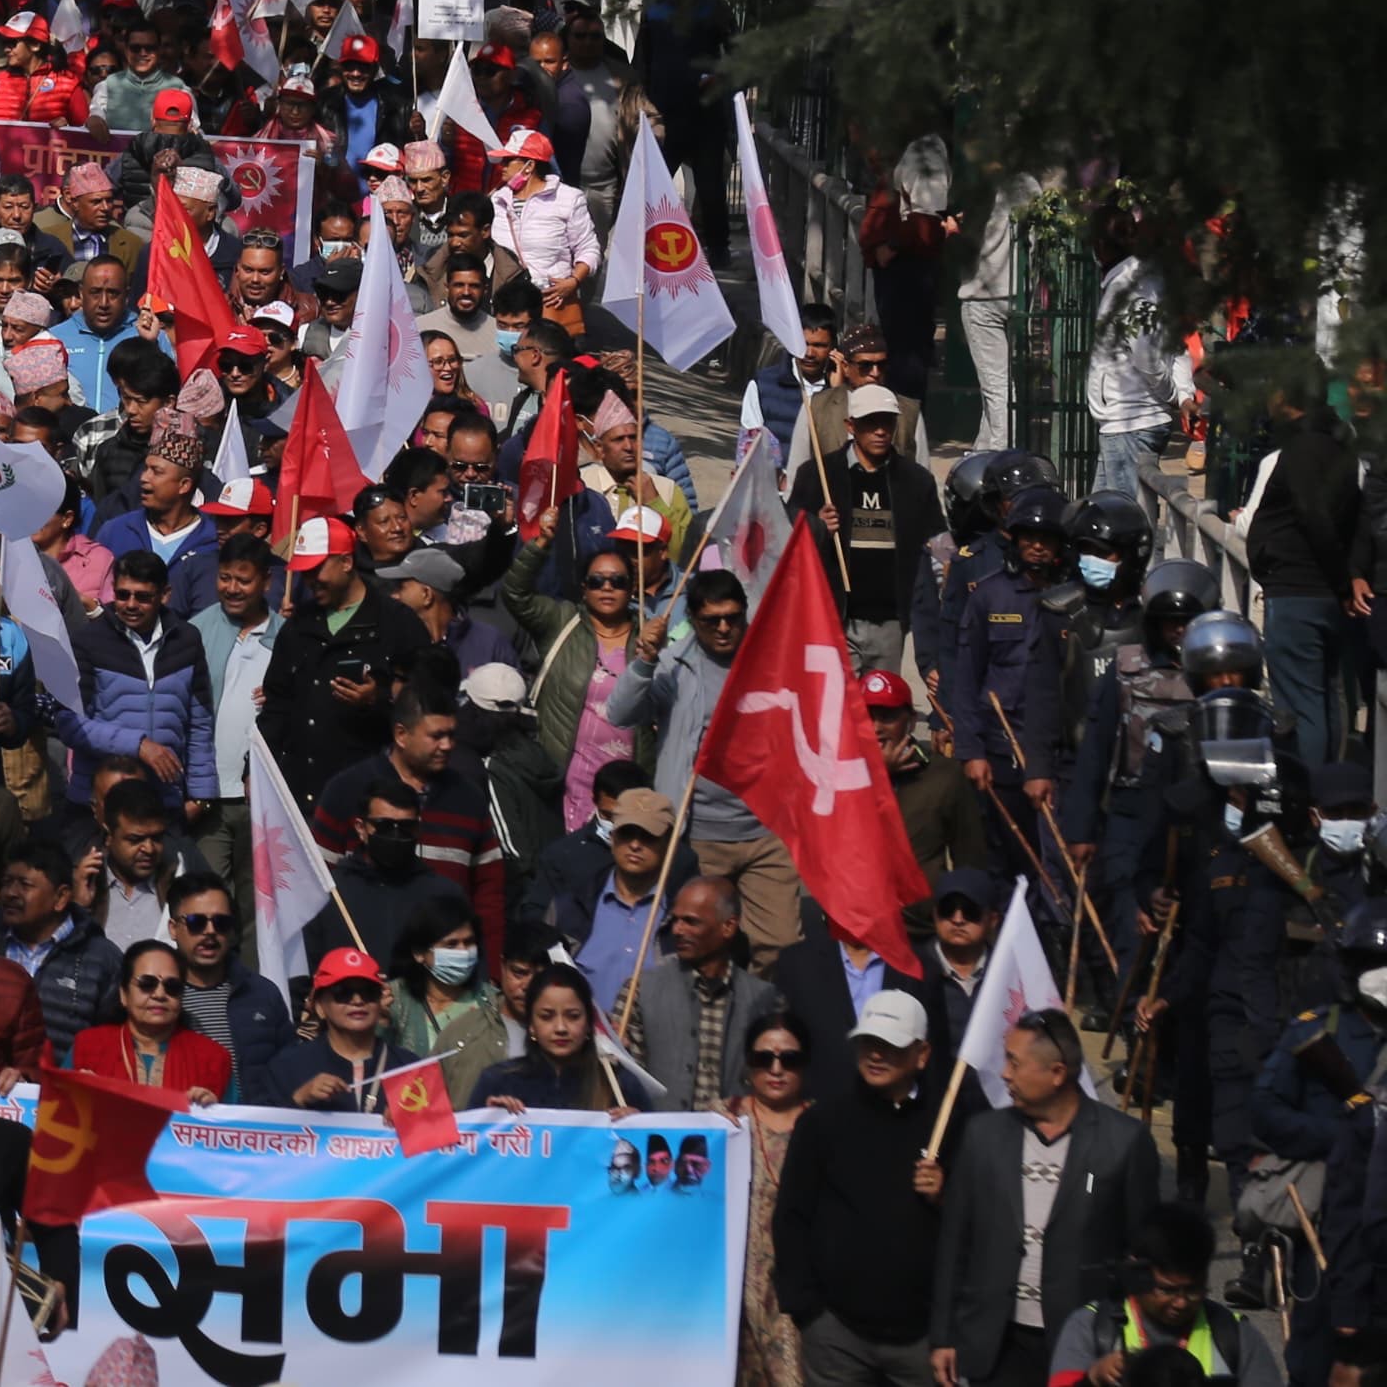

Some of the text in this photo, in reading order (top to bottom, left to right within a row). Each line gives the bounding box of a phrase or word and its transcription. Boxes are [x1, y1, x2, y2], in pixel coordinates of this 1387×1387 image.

[862, 492, 881, 509] M
[172, 1122, 316, 1157] समाजवादको
[328, 1135, 397, 1159] आधार
